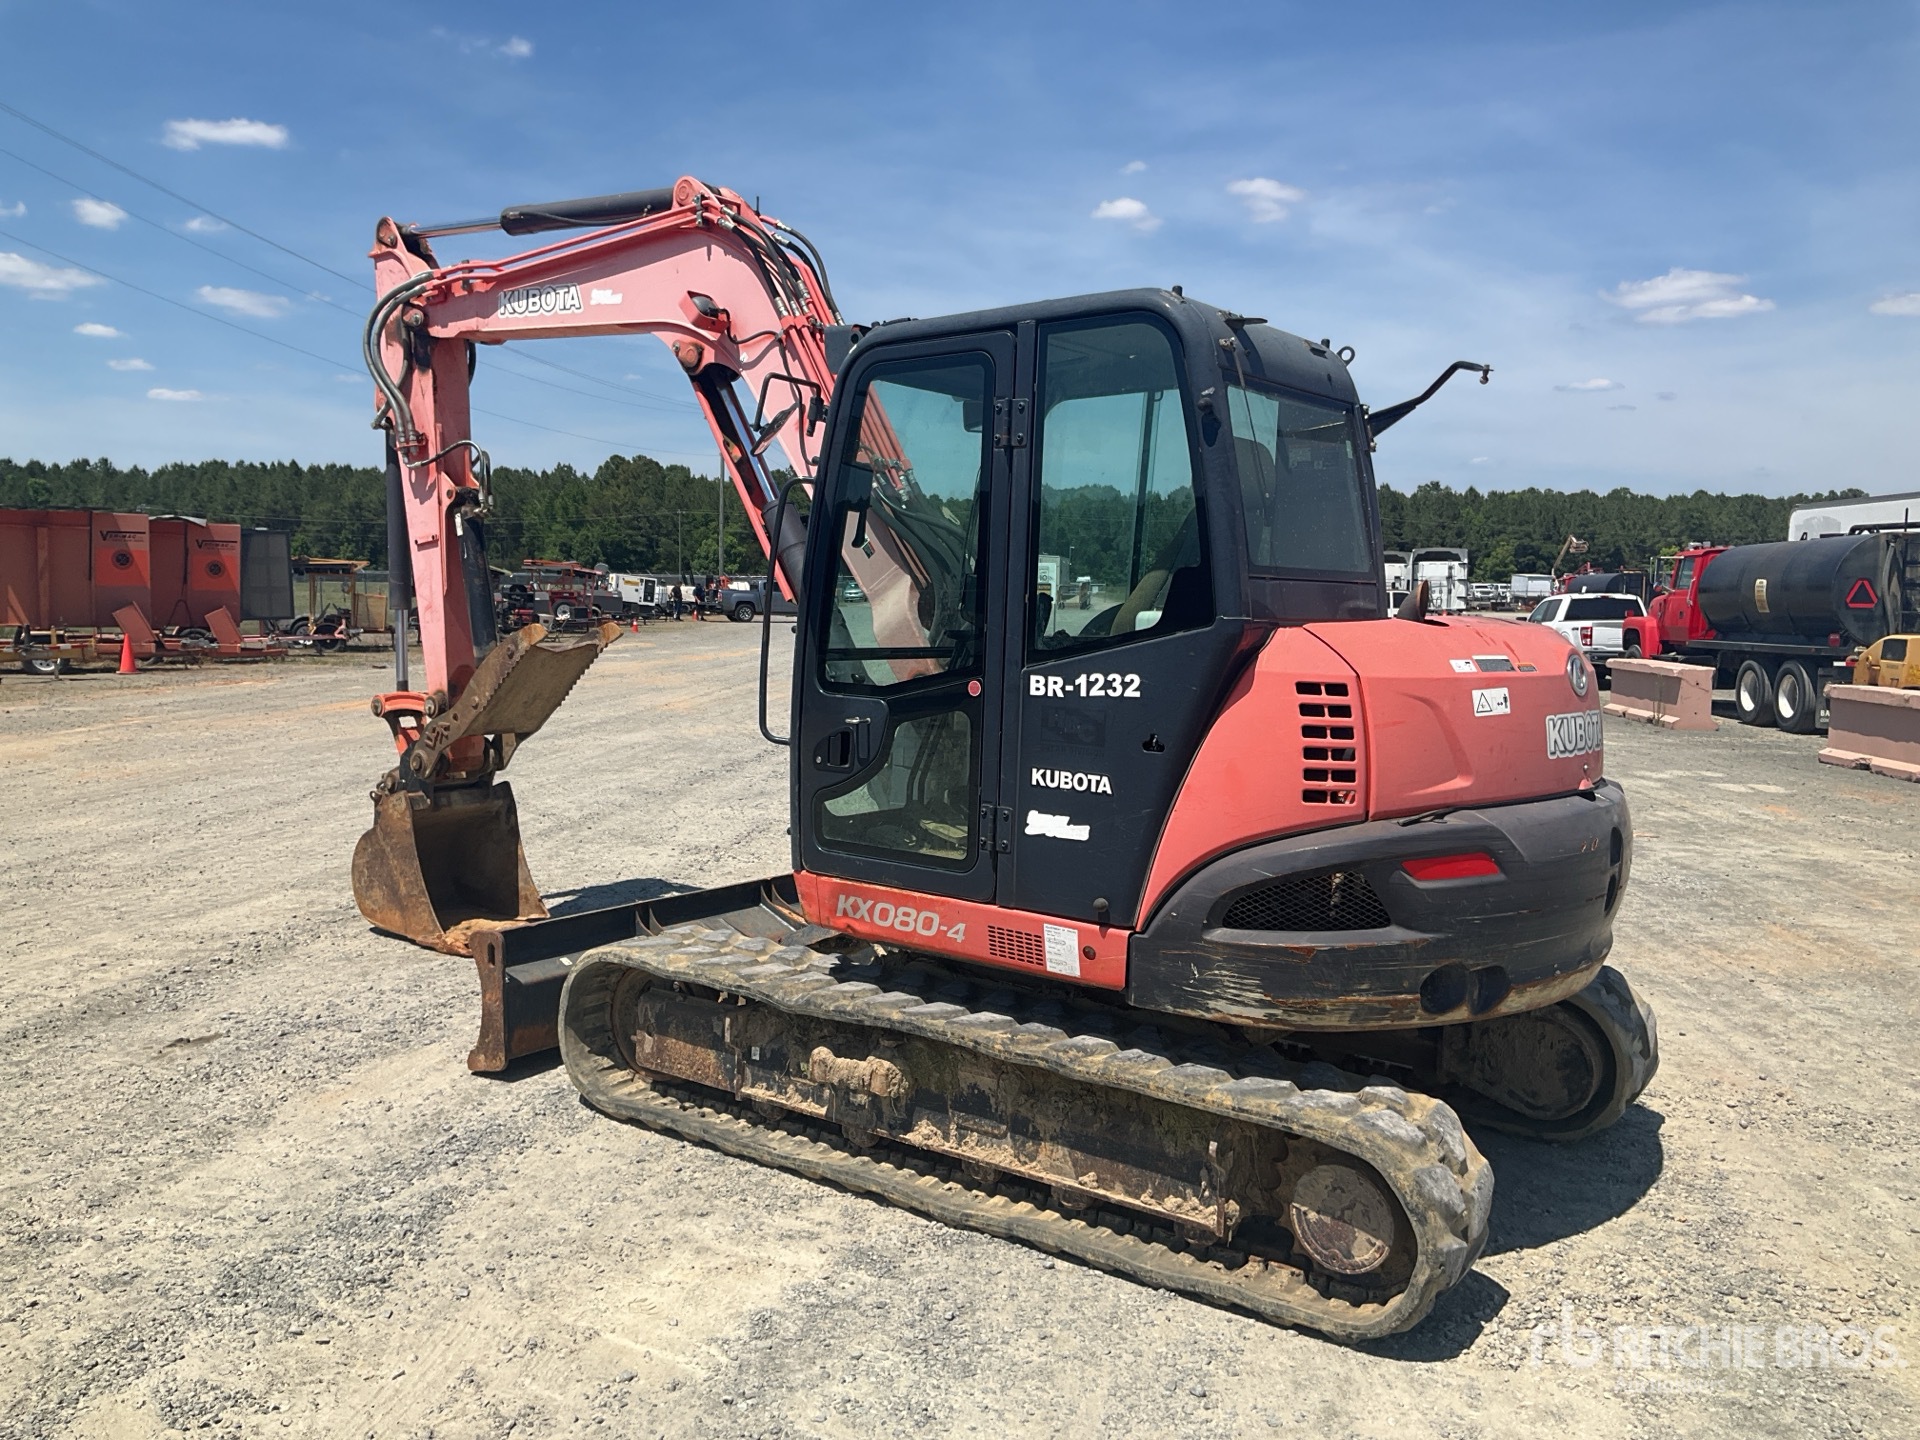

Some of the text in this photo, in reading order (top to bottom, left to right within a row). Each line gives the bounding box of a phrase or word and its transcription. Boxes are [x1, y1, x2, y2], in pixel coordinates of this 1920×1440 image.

[498, 284, 583, 316] KUBOTA
[1029, 673, 1141, 698] BR-1232
[1547, 711, 1602, 758] KUBOT
[1031, 768, 1113, 795] KUBOTA
[836, 894, 967, 944] KX080-4
